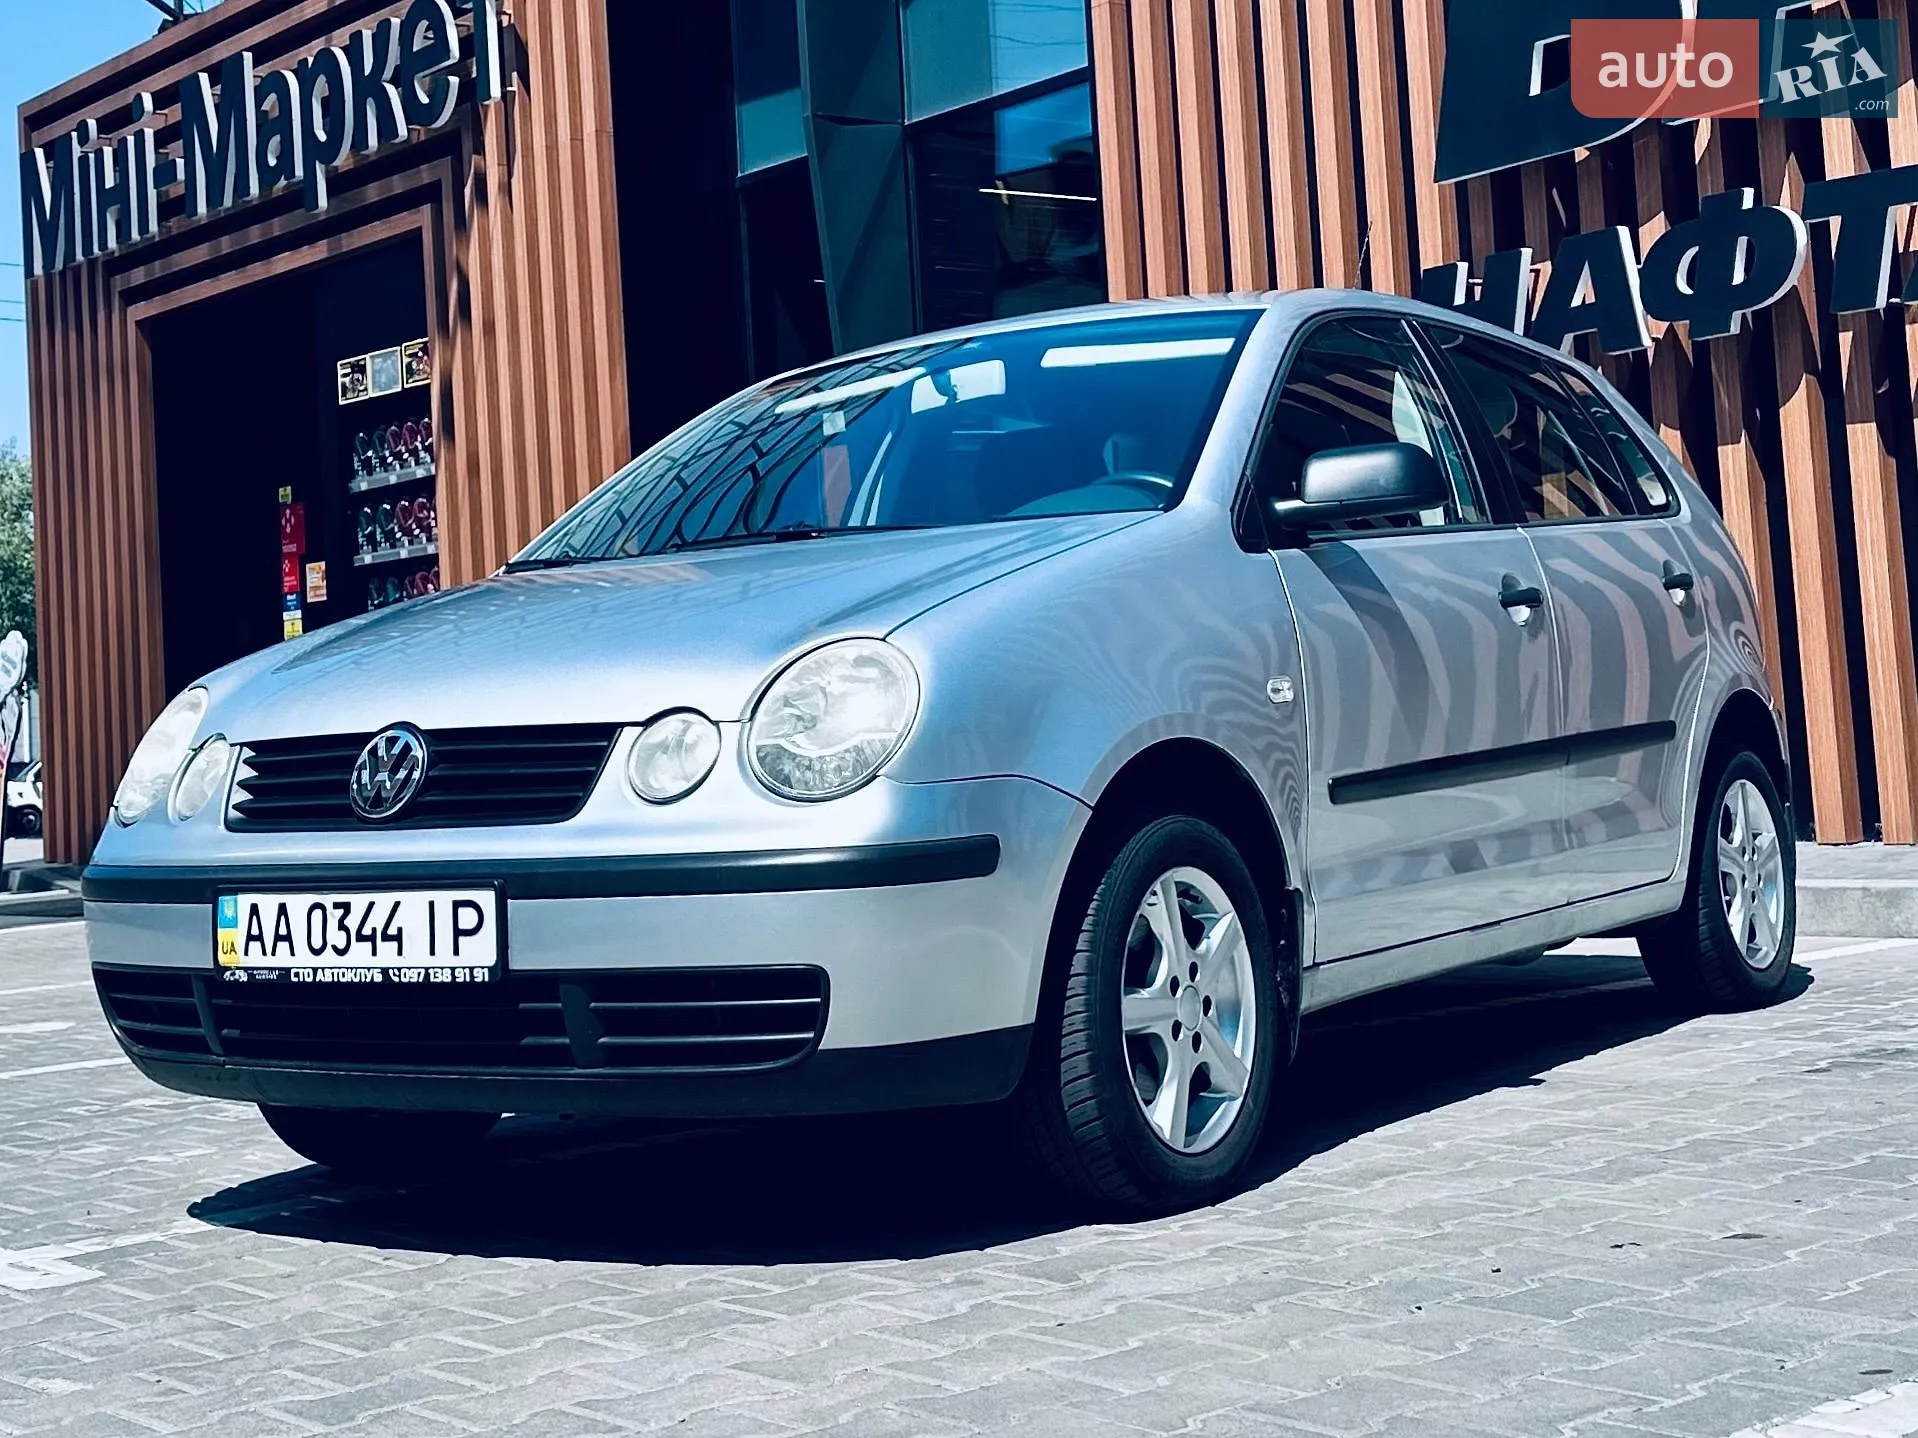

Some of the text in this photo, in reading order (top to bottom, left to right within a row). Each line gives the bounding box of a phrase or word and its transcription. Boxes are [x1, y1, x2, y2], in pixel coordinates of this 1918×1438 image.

[243, 900, 485, 957] AA 0344 IP
[221, 942, 238, 956] UA
[290, 967, 314, 983] СТО
[315, 967, 383, 983] АВТОКЛУБ
[400, 967, 426, 983] 097
[428, 967, 452, 983] 138
[454, 967, 471, 983] 91
[473, 967, 489, 983] 91
